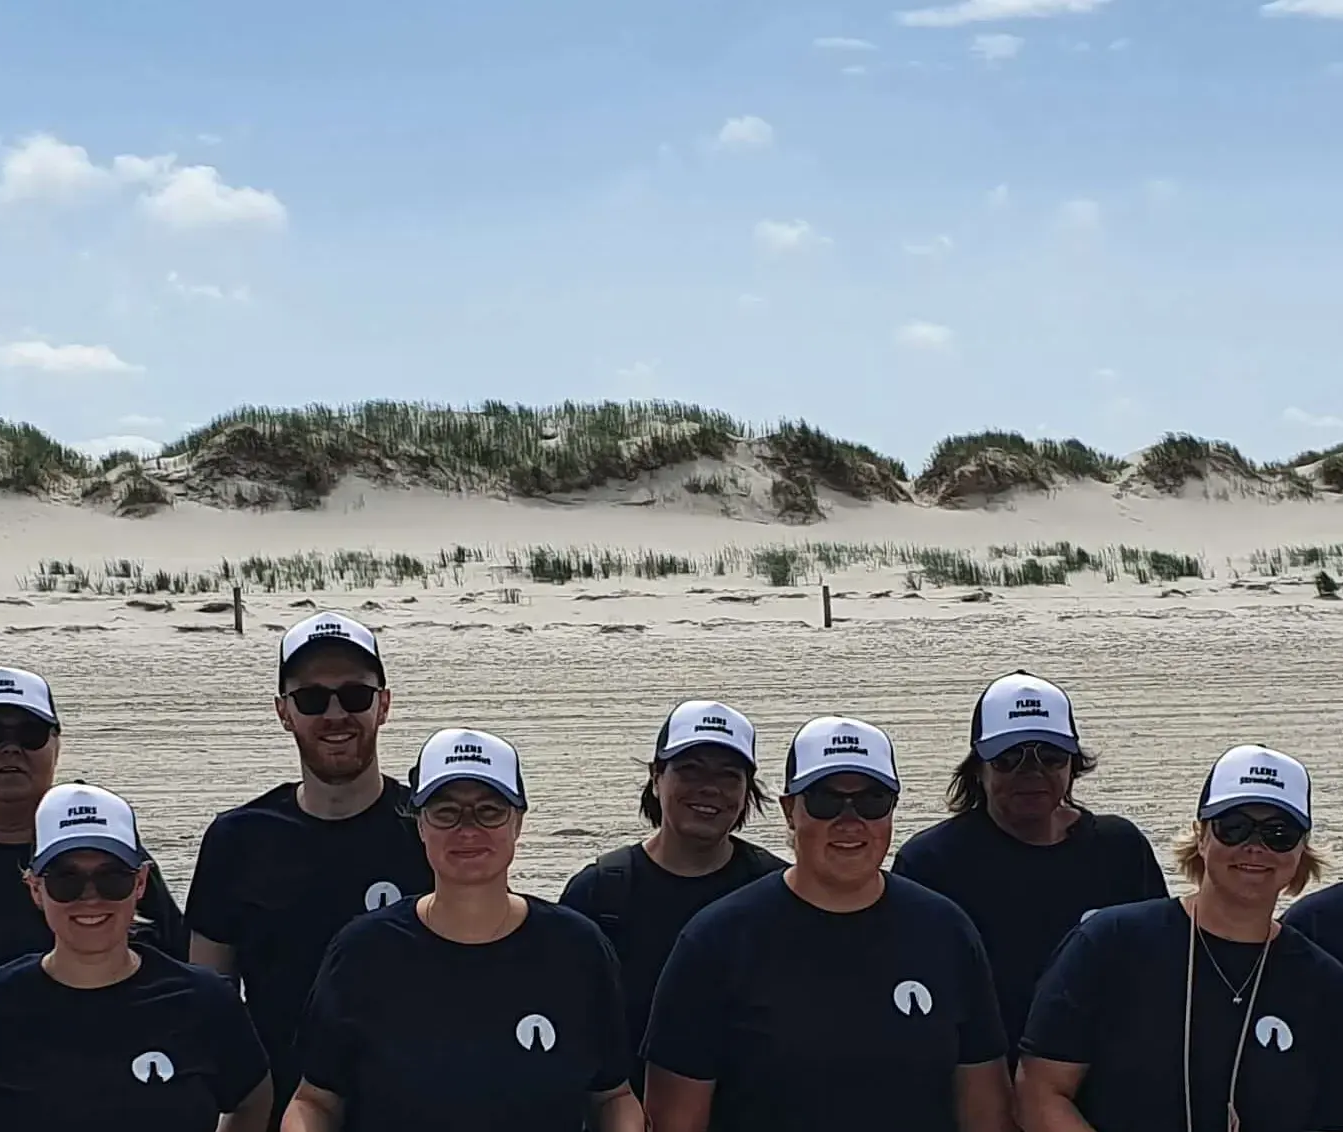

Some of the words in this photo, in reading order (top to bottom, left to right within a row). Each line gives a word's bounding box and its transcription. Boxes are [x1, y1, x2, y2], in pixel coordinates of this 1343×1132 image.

[1016, 699, 1042, 708] FLENS
[703, 717, 727, 725] FLENS
[832, 736, 859, 746] FLENS
[454, 744, 482, 754] FLENS
[1249, 767, 1277, 777] FLENS
[68, 806, 97, 817] FLENS
